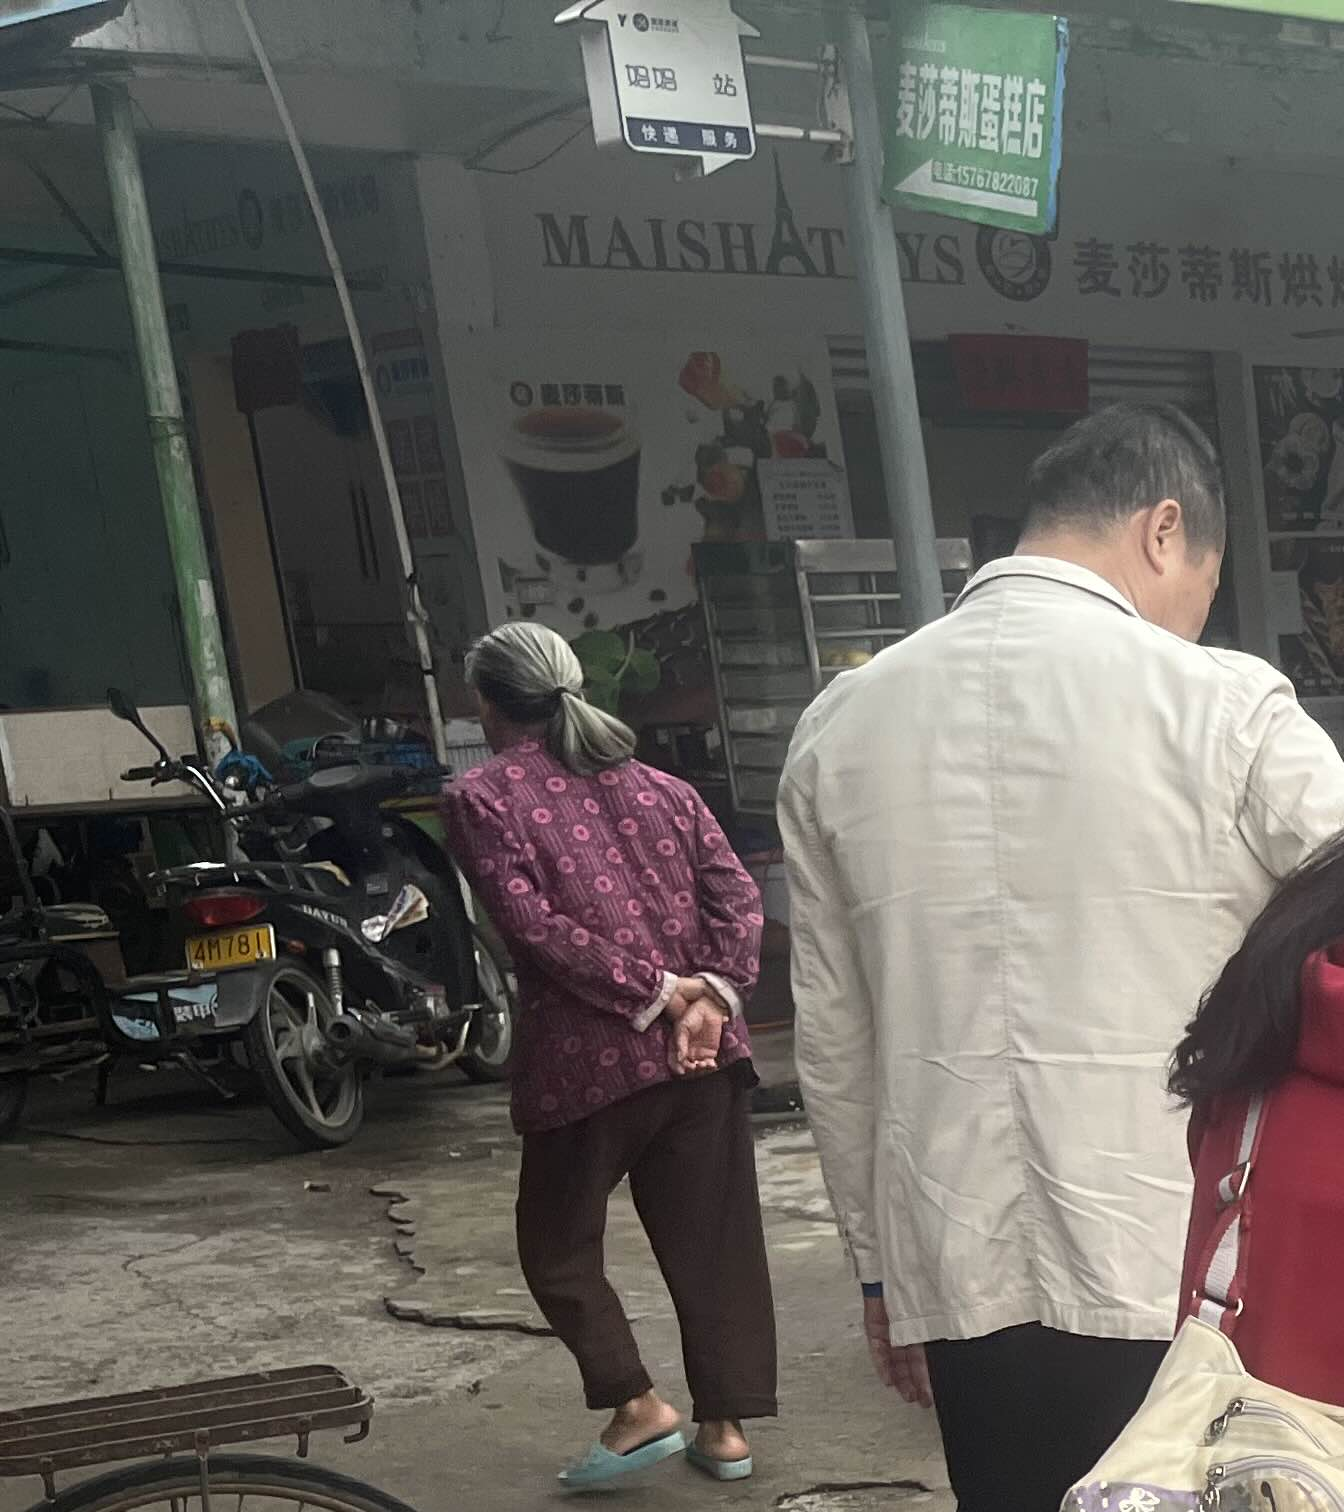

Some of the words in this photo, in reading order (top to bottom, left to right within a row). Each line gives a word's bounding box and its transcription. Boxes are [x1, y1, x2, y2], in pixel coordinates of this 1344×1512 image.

[895, 60, 1047, 159] 麦莎蒂斯蛋糕店
[535, 190, 966, 286] MAISHATYS
